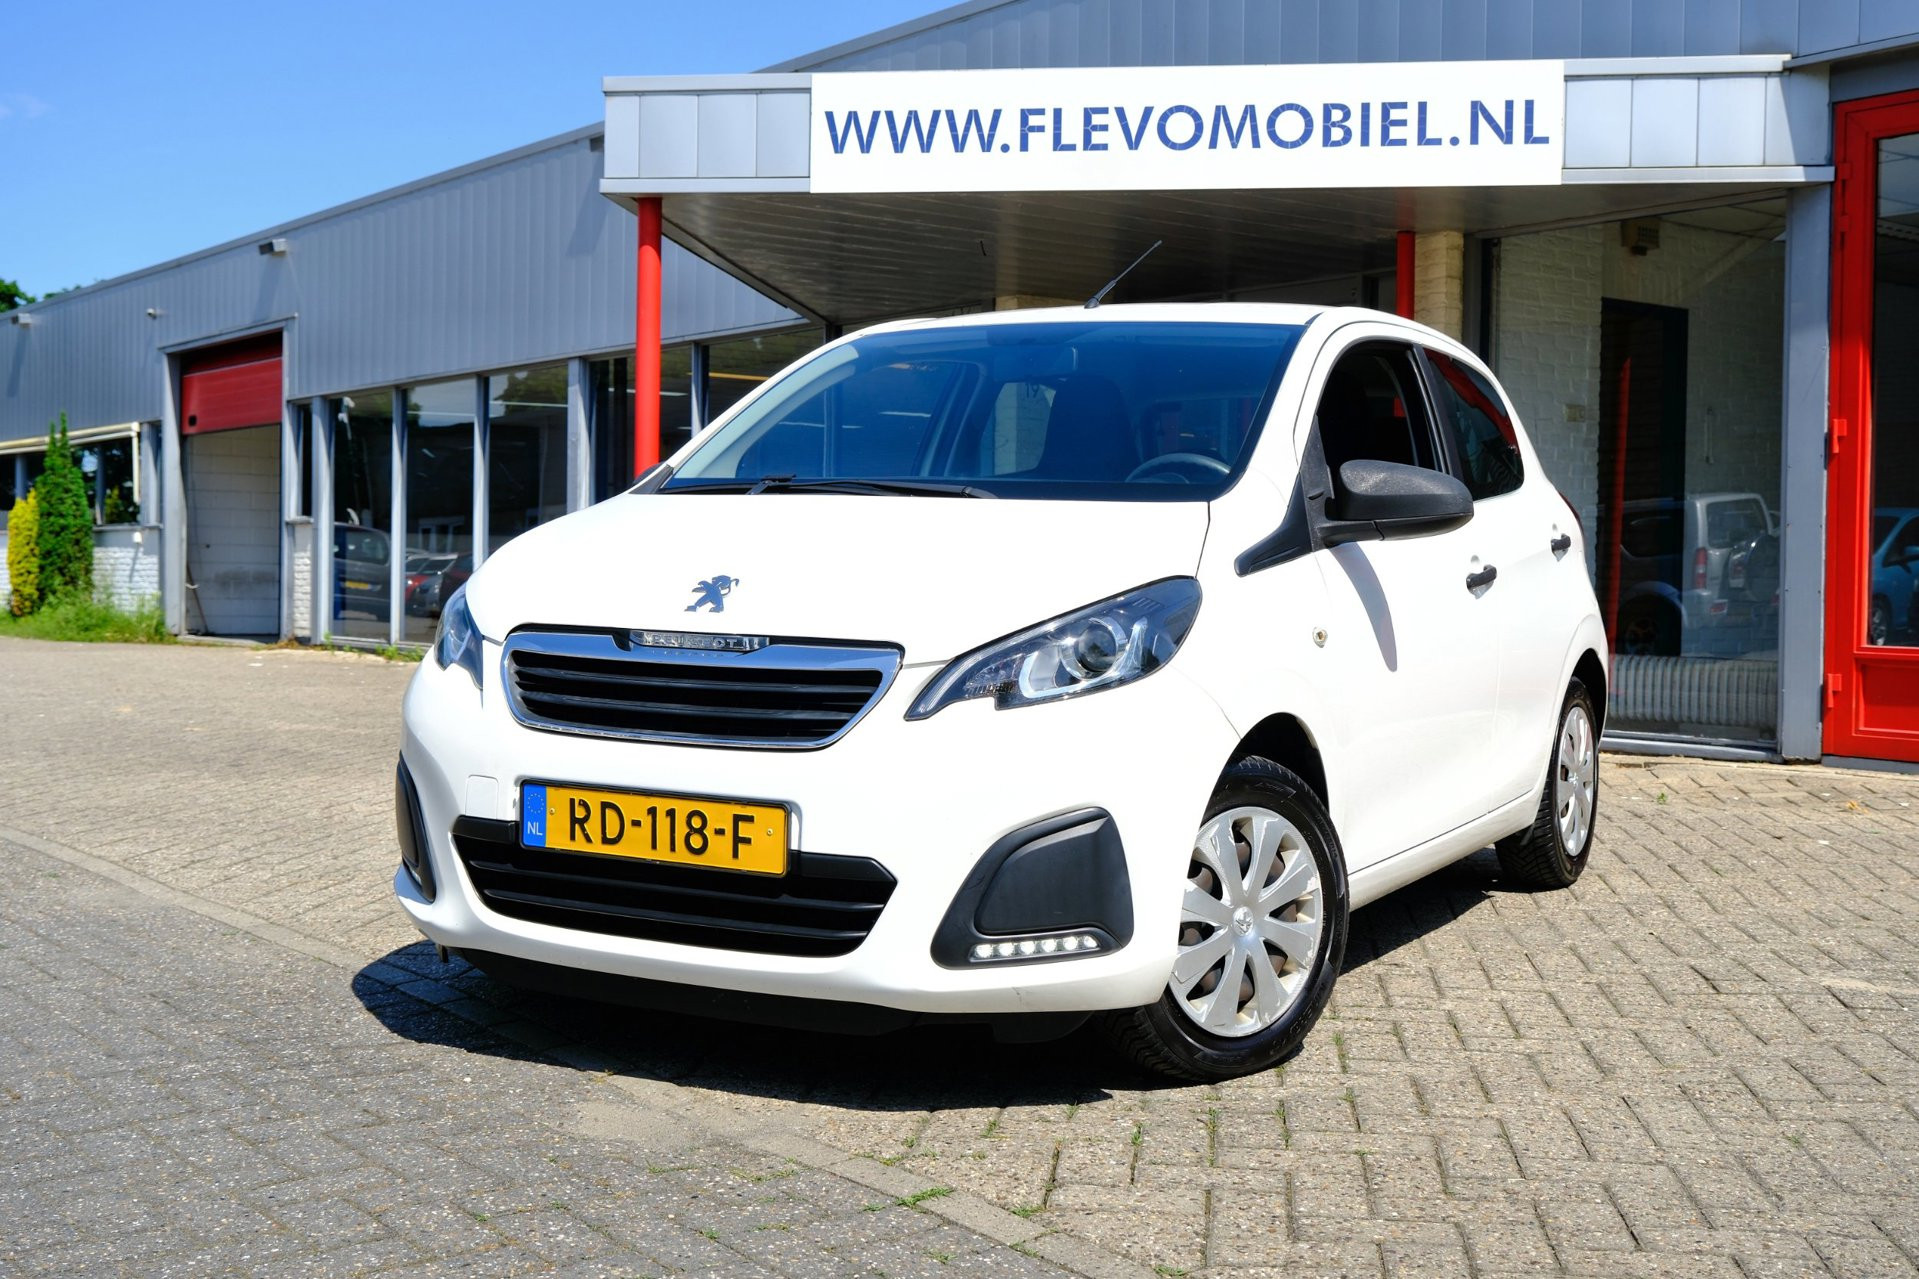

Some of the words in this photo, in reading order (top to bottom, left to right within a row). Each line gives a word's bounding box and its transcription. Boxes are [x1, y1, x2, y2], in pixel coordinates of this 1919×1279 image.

[824, 99, 1550, 154] WWW.FLEVOMOBIEL.NL
[527, 821, 543, 836] NL
[569, 798, 755, 859] RD-118-F
